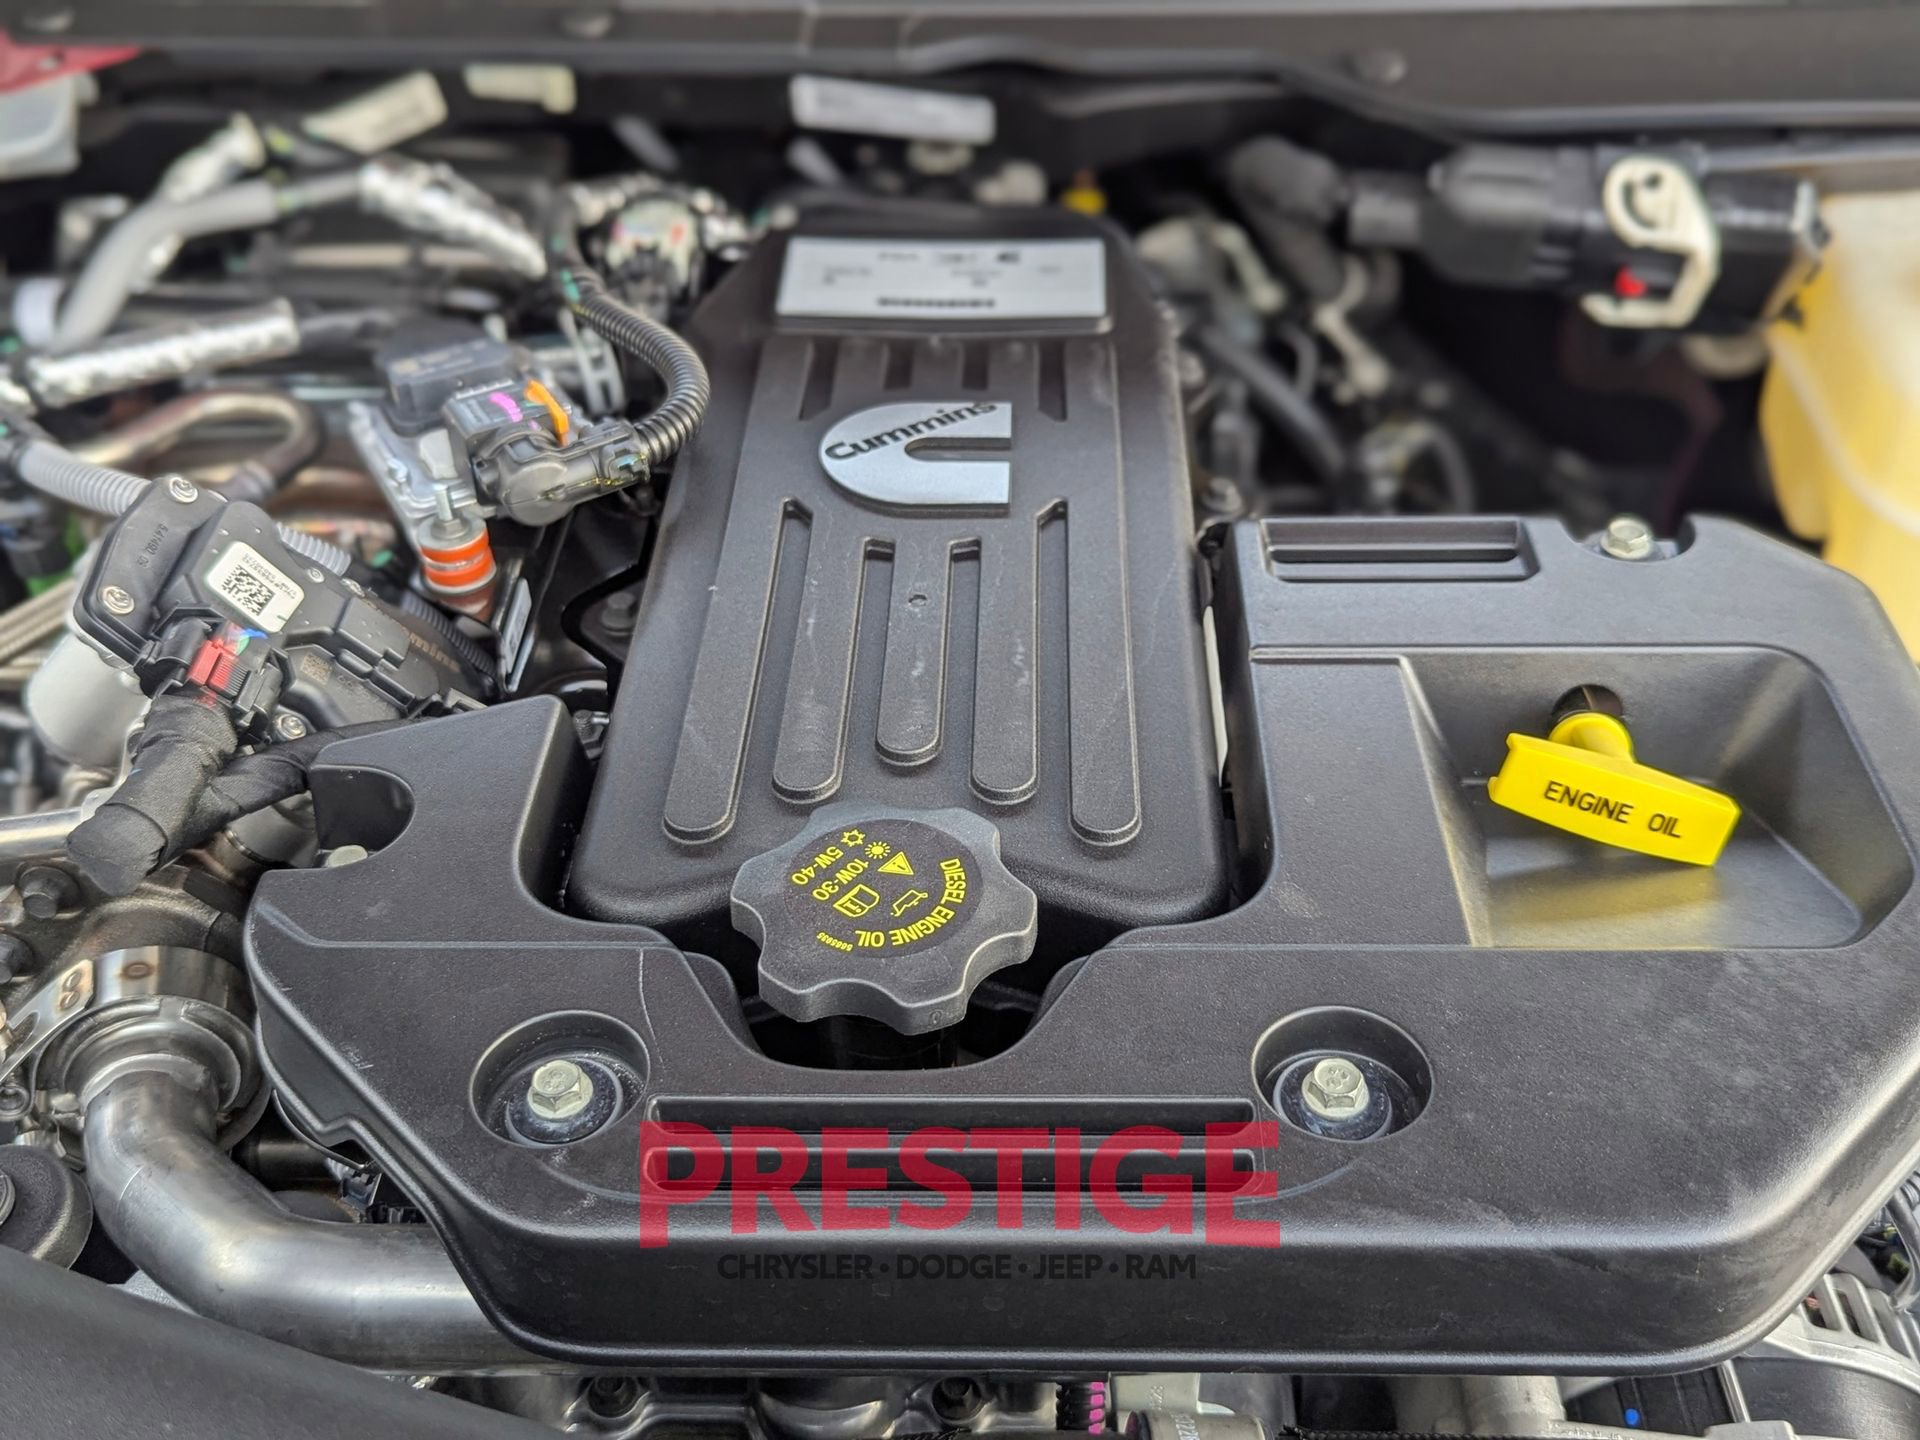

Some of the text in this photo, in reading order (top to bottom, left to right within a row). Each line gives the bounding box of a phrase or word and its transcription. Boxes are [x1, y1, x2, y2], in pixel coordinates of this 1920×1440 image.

[825, 402, 997, 460] Cummins
[1544, 780, 1681, 838] ENGINE OIL
[791, 846, 844, 885] 5W-40
[812, 858, 869, 901] 10W-30
[855, 858, 967, 947] DIESEL ENGINE OIL
